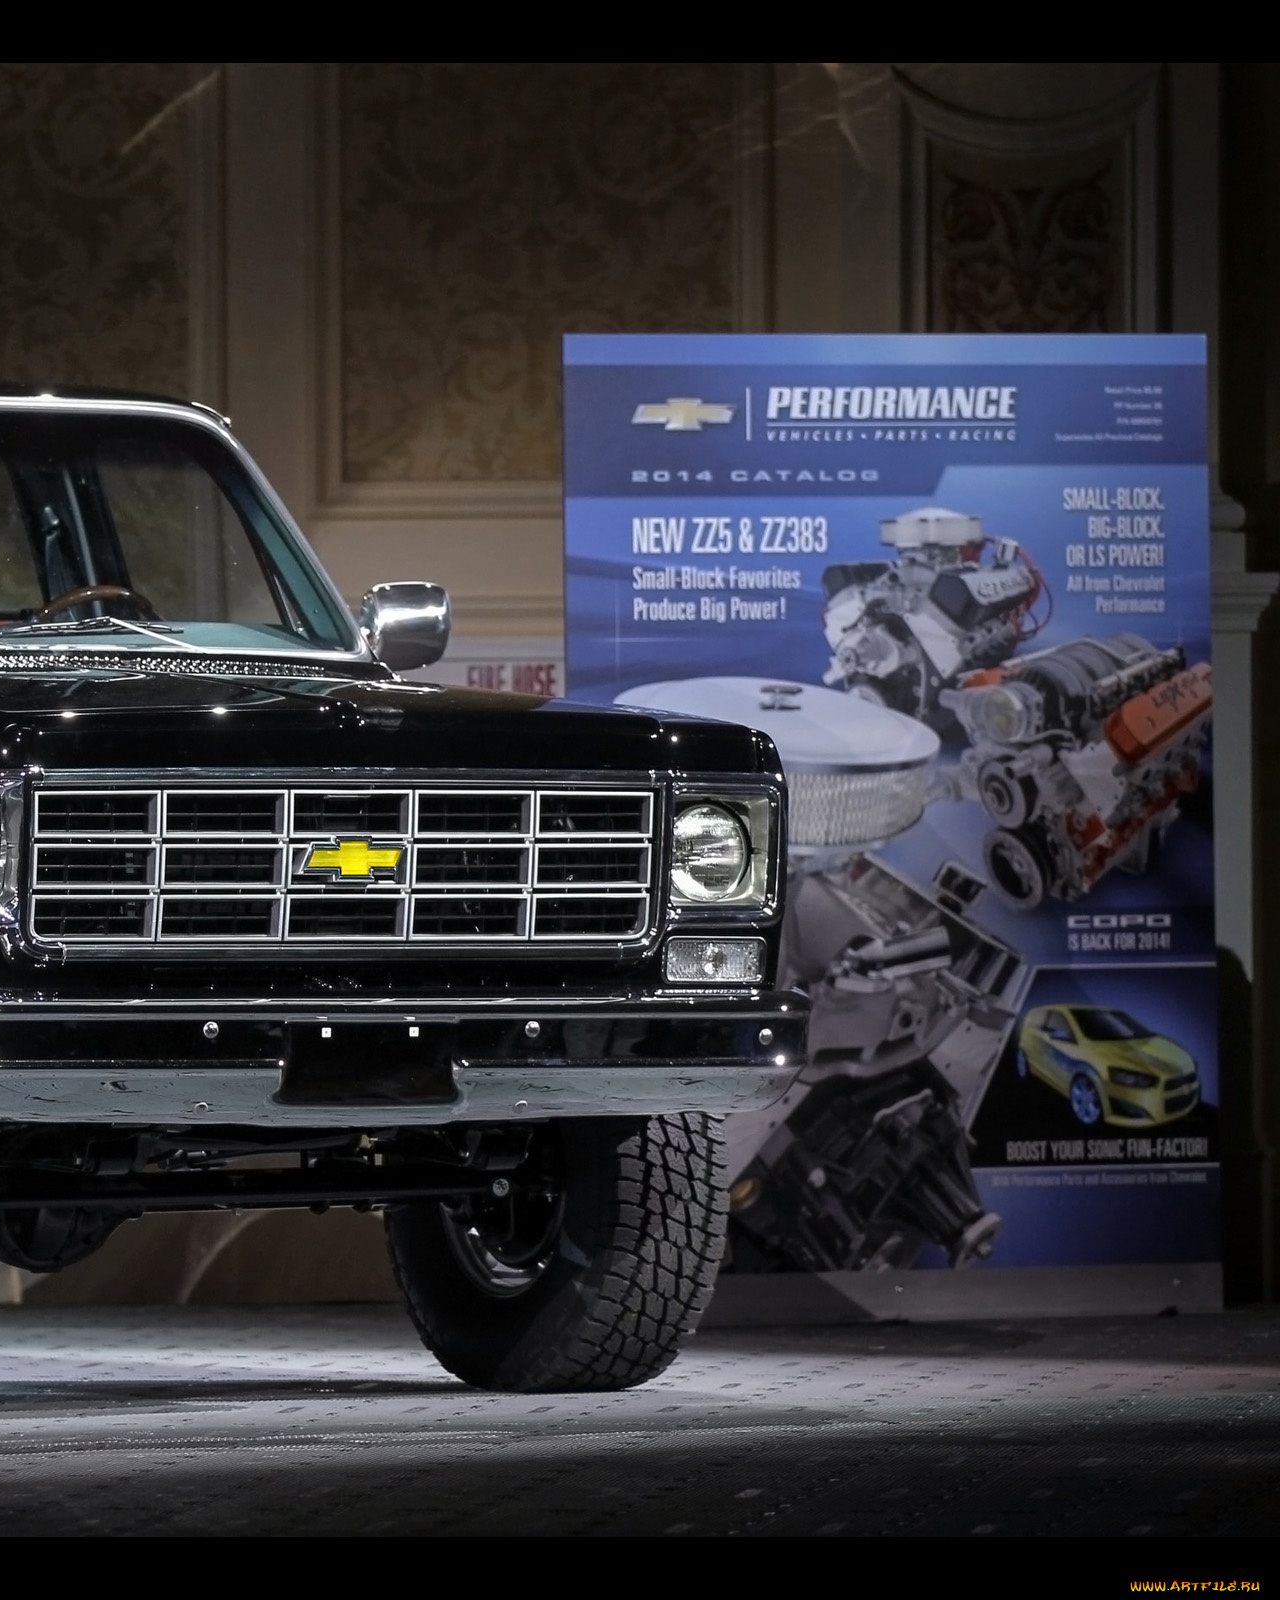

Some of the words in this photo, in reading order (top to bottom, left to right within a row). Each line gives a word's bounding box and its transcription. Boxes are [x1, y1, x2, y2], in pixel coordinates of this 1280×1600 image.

[766, 386, 1017, 419] PERFORMANCE
[767, 429, 853, 442] VEHICLES
[874, 429, 928, 441] PARTS
[948, 429, 1016, 441] RACING
[631, 470, 713, 483] 2014
[730, 469, 879, 482] CATALOG
[632, 517, 686, 553] NEW
[691, 517, 732, 553] ZZ5
[739, 517, 754, 553] &
[759, 516, 828, 553] ZZ383
[1066, 544, 1086, 567] OR
[1088, 544, 1105, 567] LS
[1109, 544, 1164, 567] POWER!
[633, 565, 725, 590] Small-Block
[729, 565, 802, 590] Favorites
[1066, 574, 1083, 592] All
[1113, 574, 1165, 592] Chevrolet
[633, 597, 696, 621] Produce
[701, 597, 726, 623] Big
[731, 597, 786, 620] Power!
[1096, 595, 1166, 613] Performance
[1067, 914, 1171, 928] COPO
[1067, 933, 1079, 951] IS
[1081, 932, 1112, 950] BACK
[1114, 932, 1136, 950] FOR
[1138, 932, 1170, 950] 2014!
[1006, 1141, 1047, 1161] BOOST
[1050, 1140, 1084, 1160] YOUR
[1087, 1139, 1124, 1159] SONIC
[1126, 1137, 1208, 1159] FUN-FACTOR!
